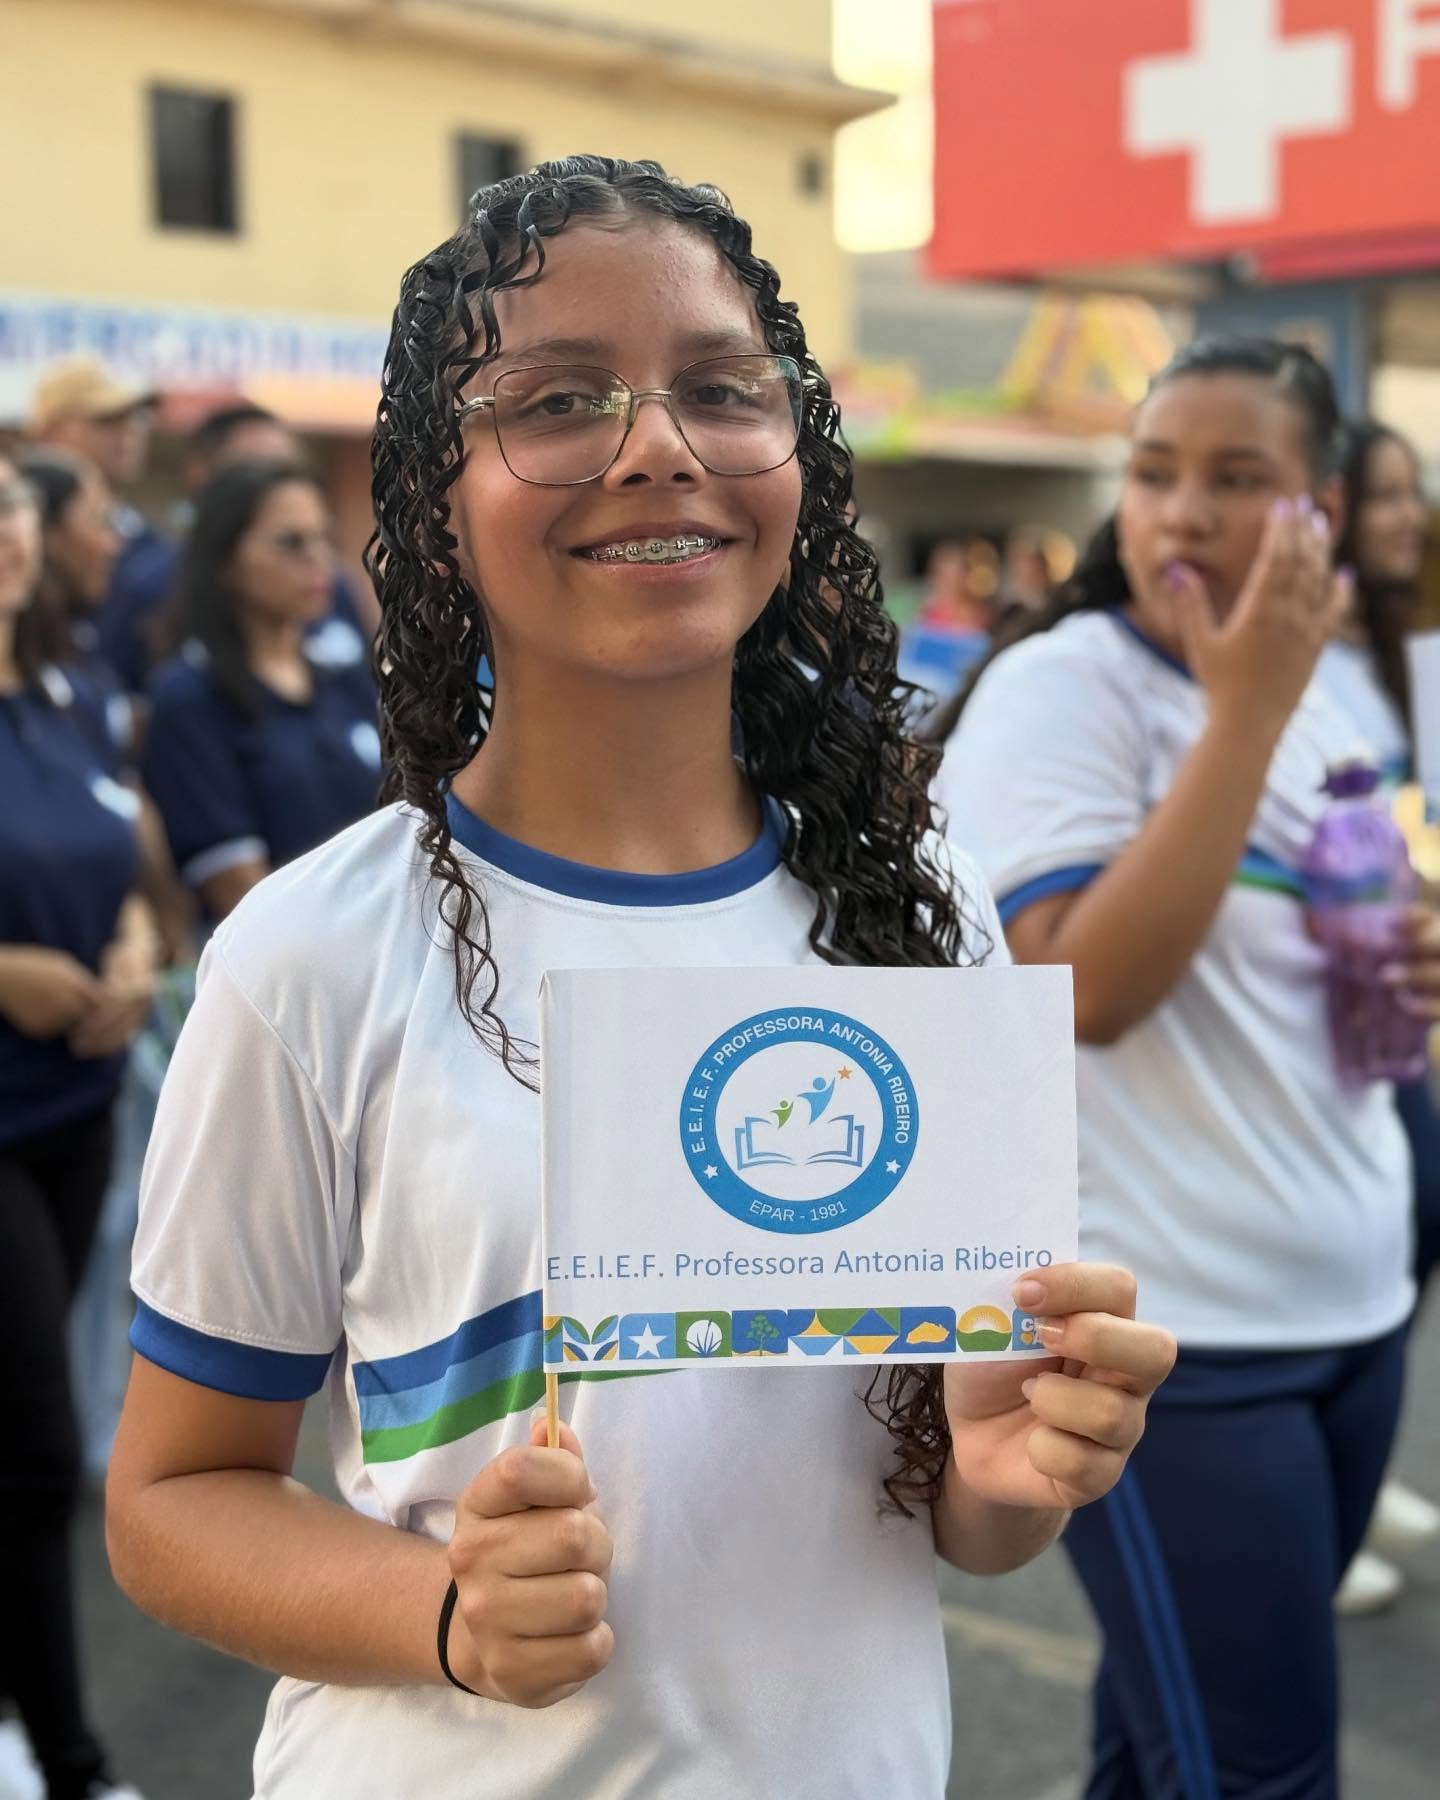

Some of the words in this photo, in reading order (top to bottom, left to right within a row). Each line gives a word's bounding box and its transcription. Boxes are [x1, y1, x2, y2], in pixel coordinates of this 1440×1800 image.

[713, 1016, 824, 1065] PROFESSORA
[828, 1022, 893, 1076] ANTONIA
[887, 1075, 910, 1144] RIBEIRO
[749, 1199, 795, 1222] EPAR
[809, 1200, 848, 1221] 1981
[547, 1254, 664, 1280] E.E.I.E.F.
[675, 1251, 824, 1277] Professora
[834, 1248, 944, 1274] Antonia
[954, 1245, 1053, 1271] Ribeiro
